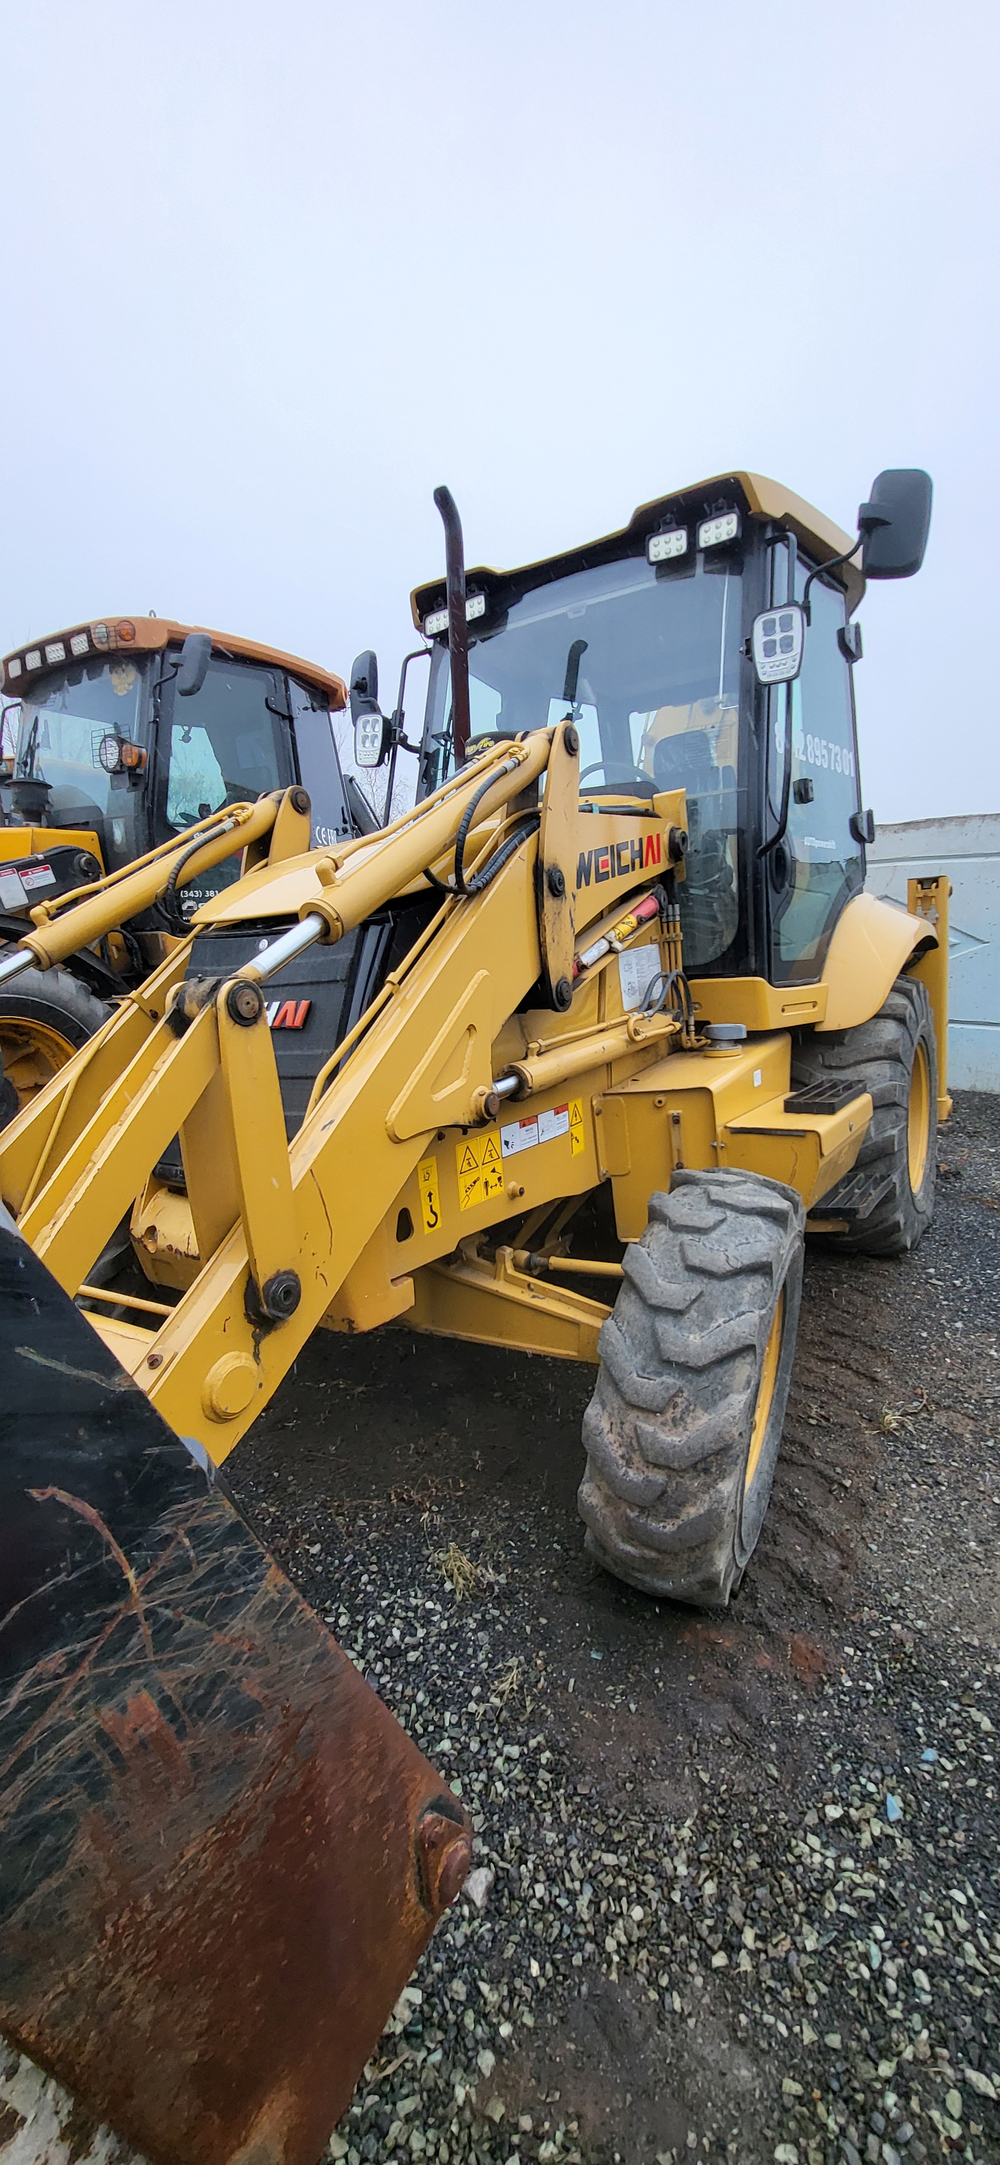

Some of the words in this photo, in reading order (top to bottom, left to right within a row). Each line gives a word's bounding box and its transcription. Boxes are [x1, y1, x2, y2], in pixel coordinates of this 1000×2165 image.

[576, 833, 661, 890] WEICHAI
[180, 890, 203, 898] (343)
[204, 890, 219, 898] 381
